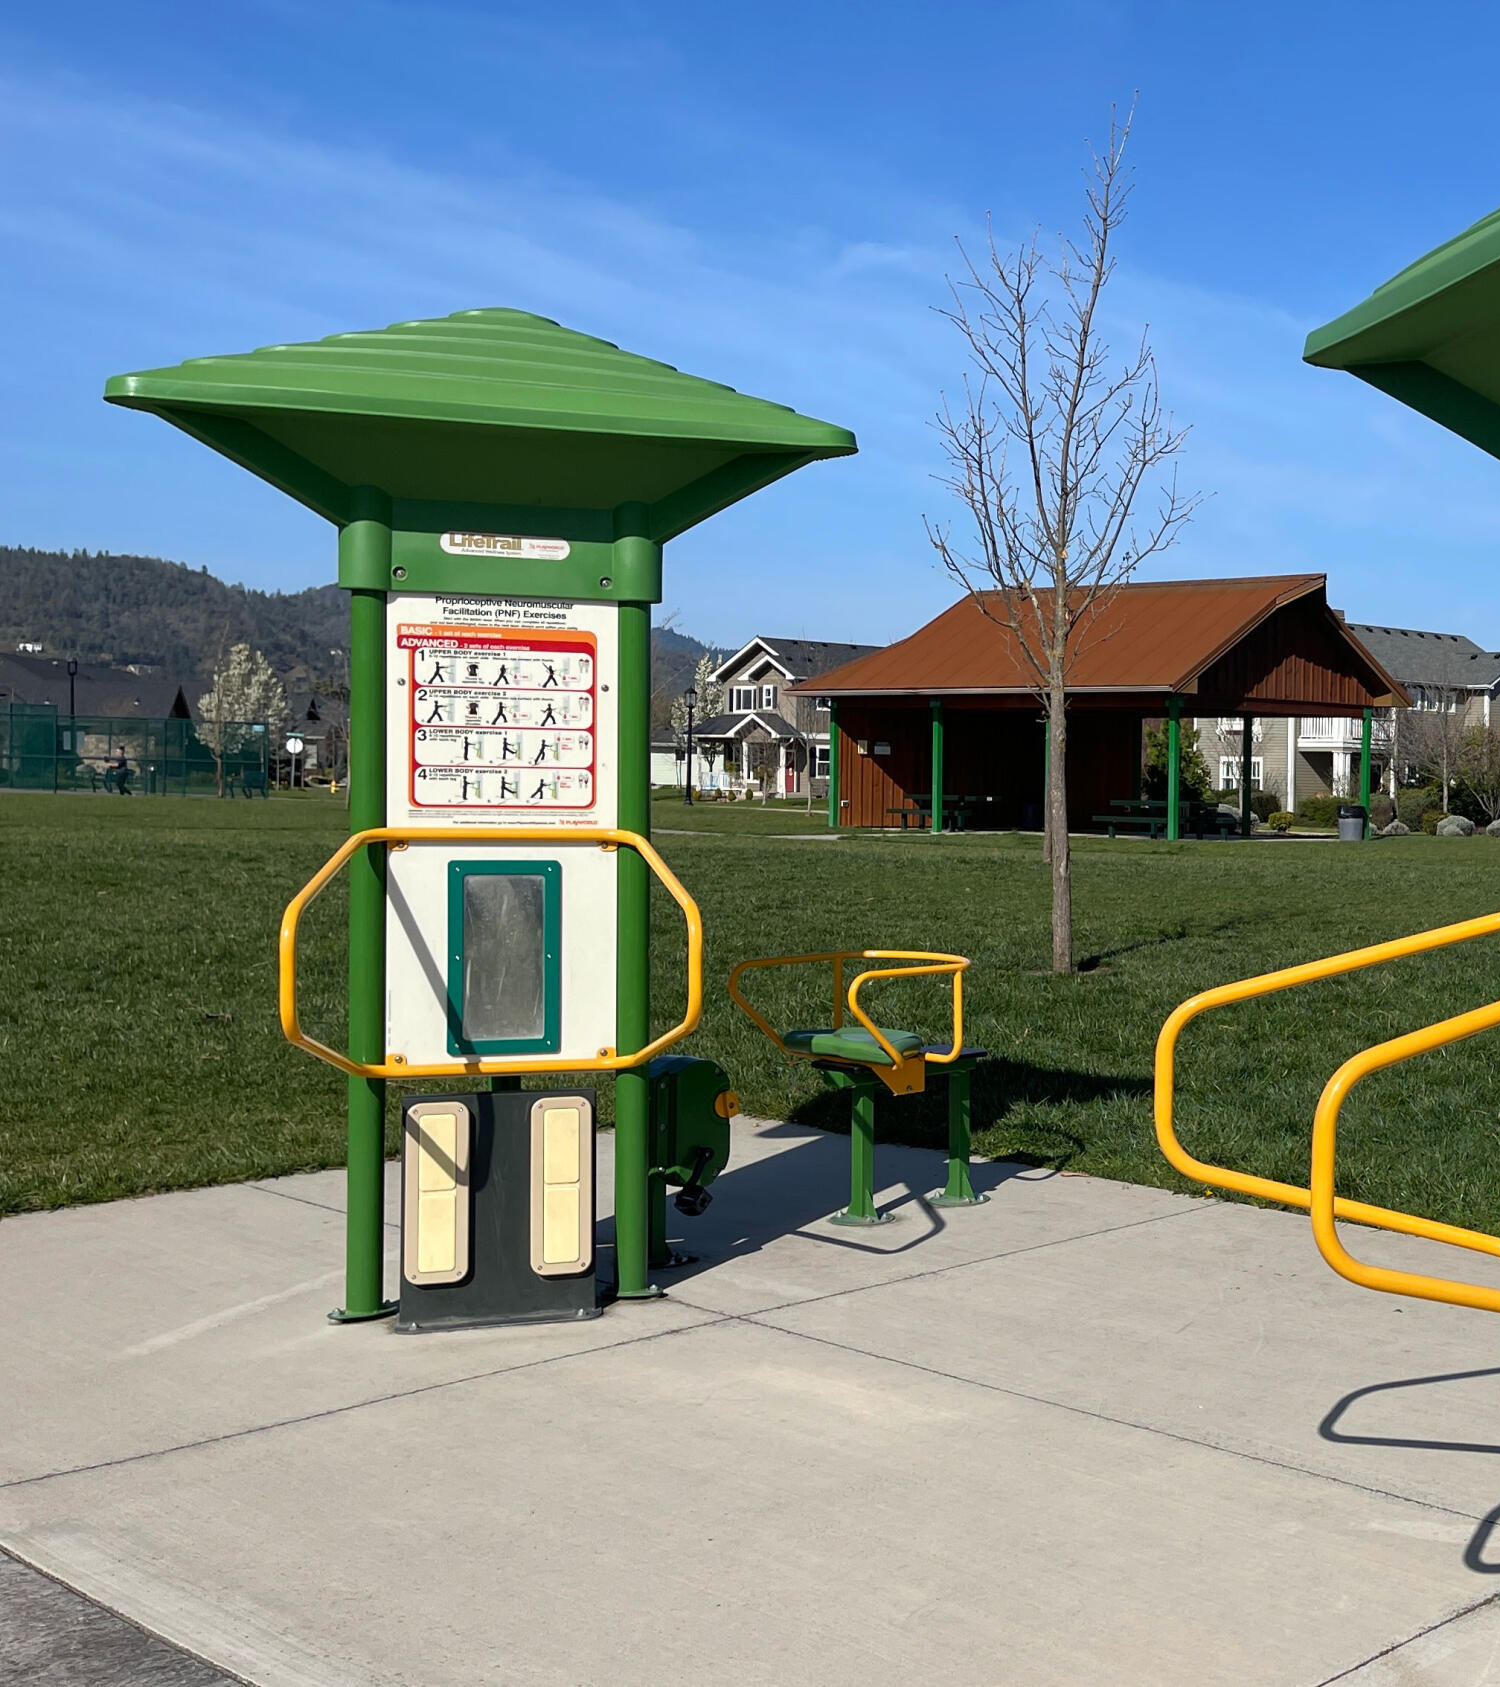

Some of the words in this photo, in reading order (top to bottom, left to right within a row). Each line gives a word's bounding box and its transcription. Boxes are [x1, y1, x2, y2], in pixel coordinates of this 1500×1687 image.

[449, 533, 521, 550] LifeTrail
[436, 596, 502, 607] Proprioceptive
[504, 600, 573, 610] Neuromuscular
[443, 607, 492, 617] Facilitation
[495, 609, 520, 619] (PNF)
[523, 611, 566, 620] Exercises
[401, 626, 433, 636] BASIC
[401, 638, 458, 648] ADVANCED
[419, 650, 424, 661] 1
[418, 689, 428, 701] 2
[417, 730, 427, 741] 3
[418, 769, 427, 780] 4
